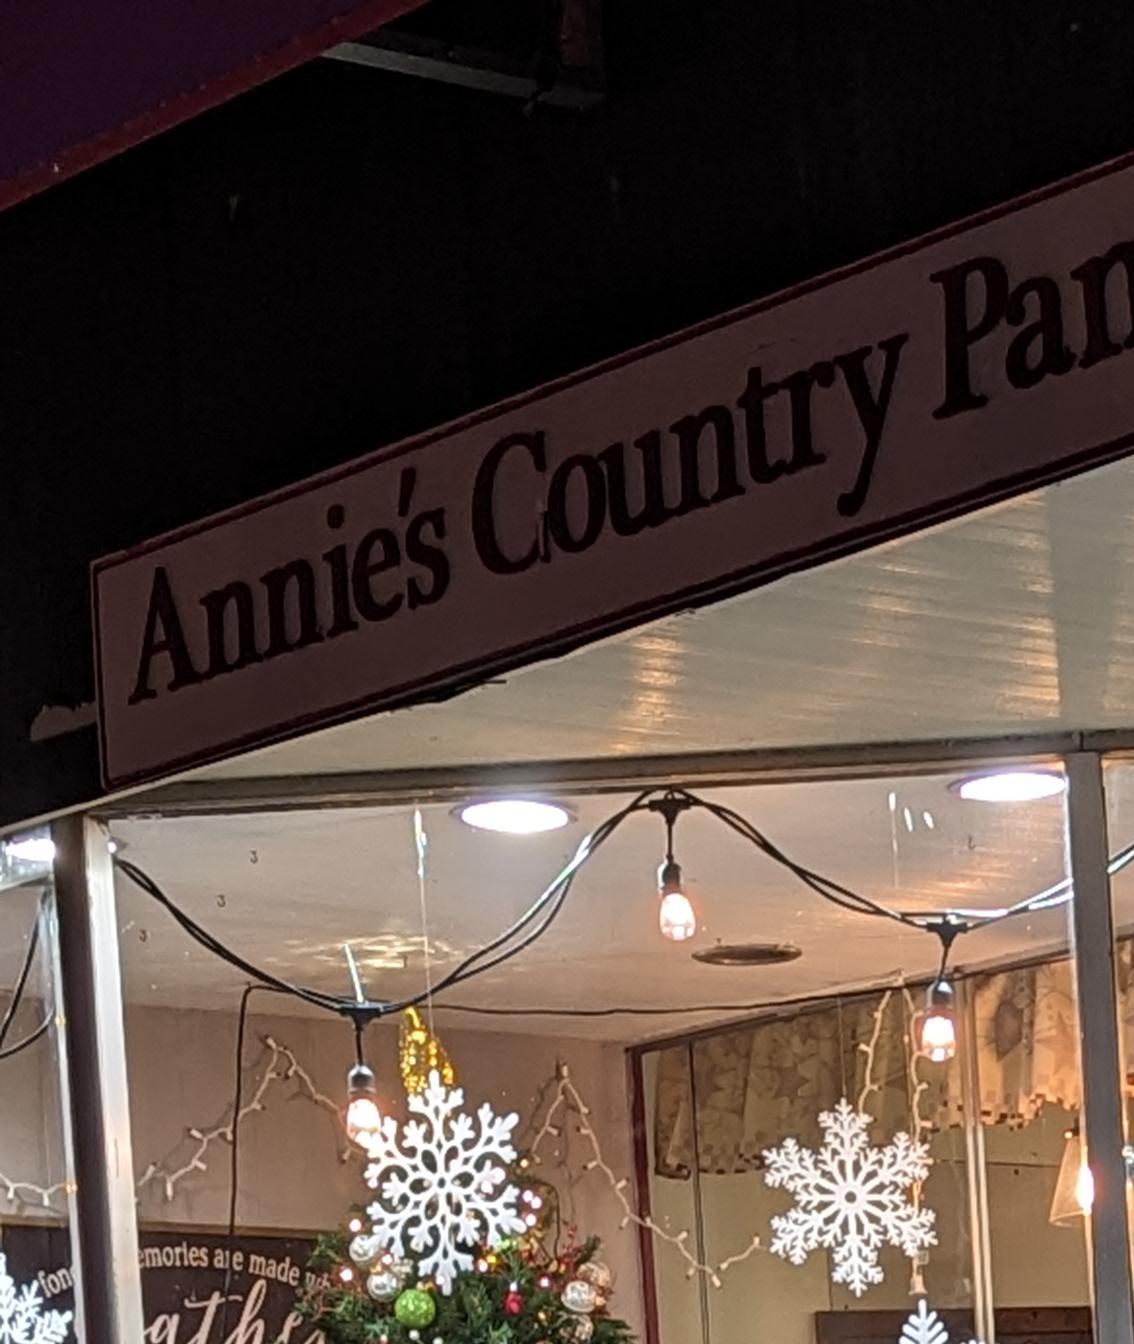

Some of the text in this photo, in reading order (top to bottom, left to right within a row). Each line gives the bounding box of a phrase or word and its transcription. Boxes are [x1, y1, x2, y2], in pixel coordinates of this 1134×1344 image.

[128, 468, 450, 705] Annie's
[472, 334, 908, 575] Country
[138, 1240, 209, 1269] emories
[248, 1253, 300, 1287] made
